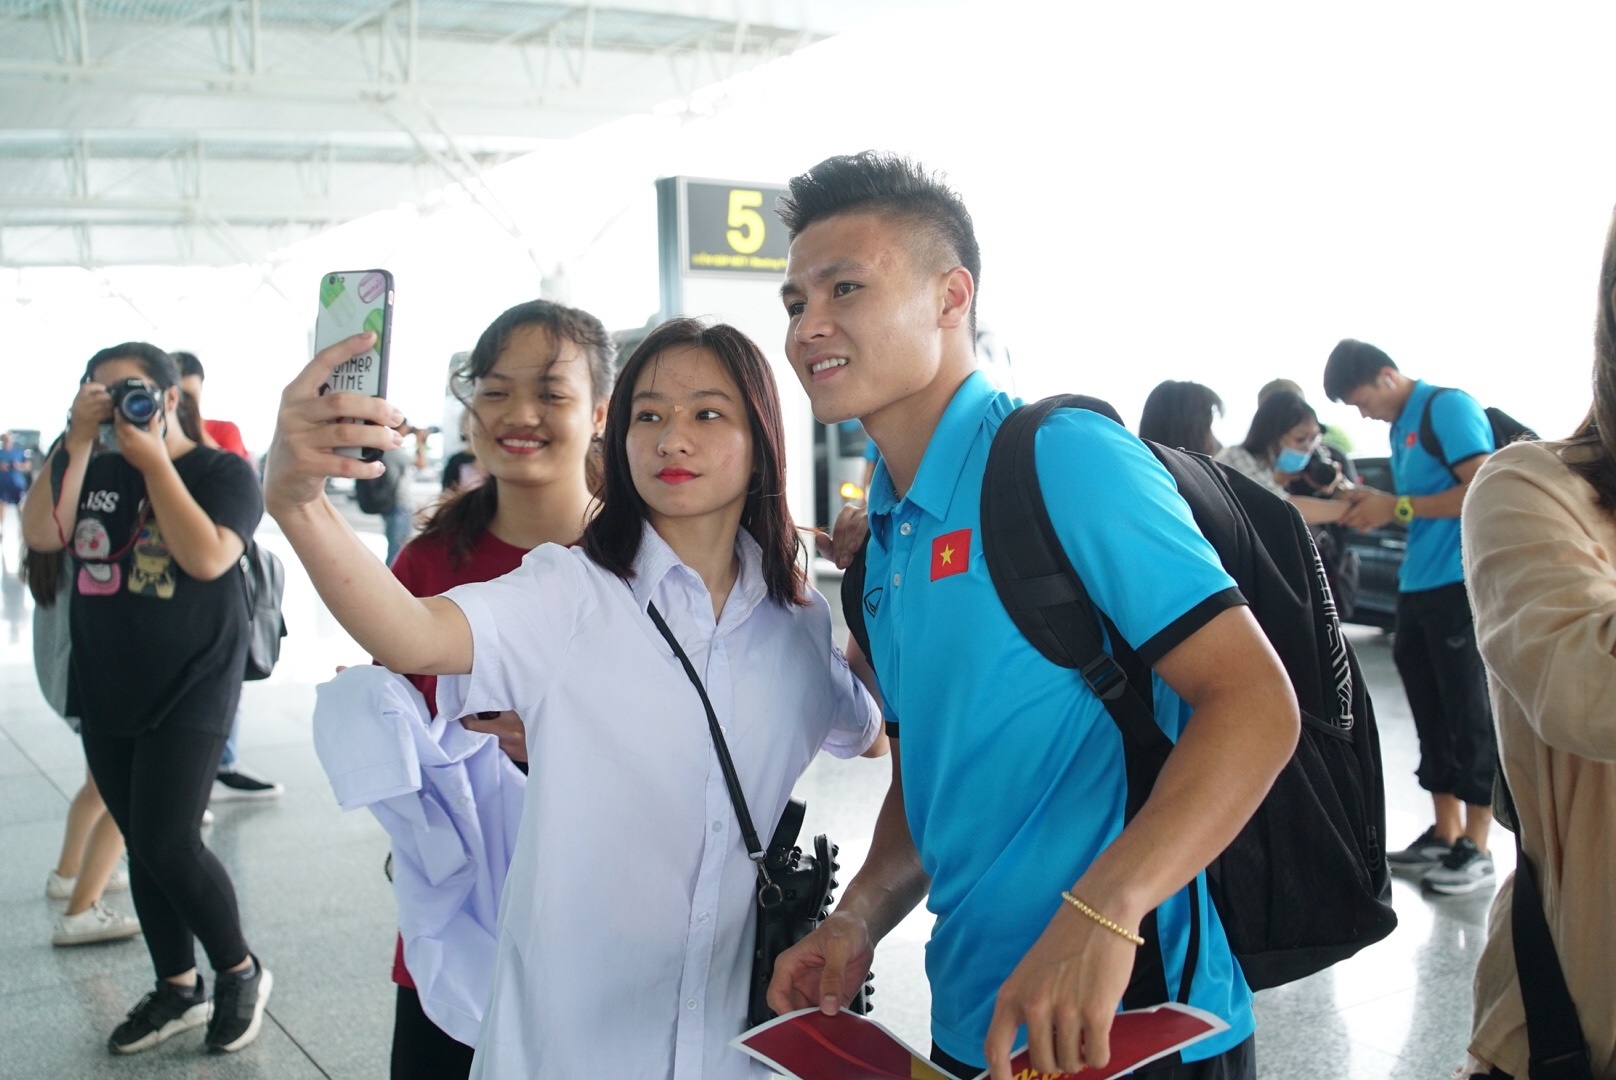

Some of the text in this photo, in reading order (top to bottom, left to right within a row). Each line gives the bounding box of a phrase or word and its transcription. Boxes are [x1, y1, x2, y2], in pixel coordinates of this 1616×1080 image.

[726, 189, 765, 254] 5
[332, 374, 364, 391] TIME
[81, 489, 119, 513] ISS
